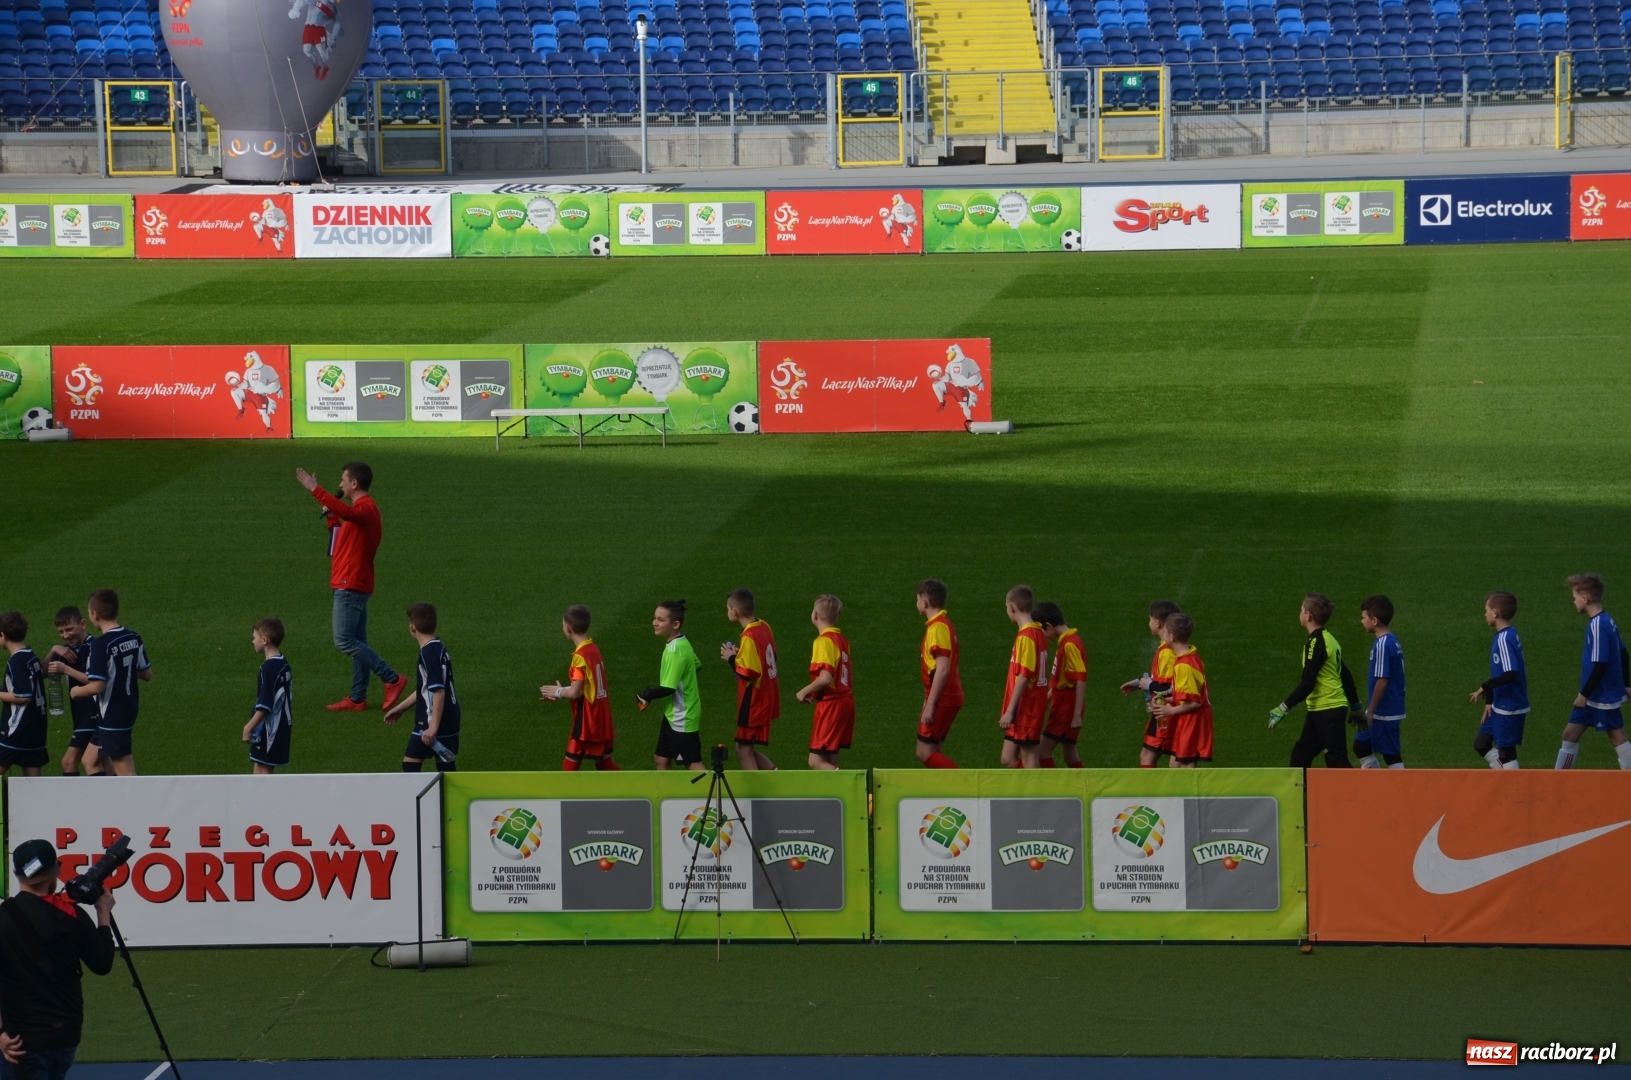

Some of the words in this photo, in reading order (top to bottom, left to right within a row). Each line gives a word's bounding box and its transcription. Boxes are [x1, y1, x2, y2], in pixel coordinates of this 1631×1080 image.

[171, 22, 191, 34] PZPN
[1126, 77, 1137, 86] 46
[866, 83, 877, 92] 45
[134, 91, 146, 100] 43
[406, 90, 417, 99] 44
[467, 208, 491, 216] TYMBARK
[969, 205, 994, 213] TYMBARK
[1032, 204, 1057, 212] TYMBARK
[1364, 208, 1389, 216] TYMBARK
[1457, 200, 1553, 217] Electrolux
[312, 206, 433, 226] DZIENNIK
[498, 209, 523, 218] TYMBARK
[560, 209, 586, 217] TYMBARK
[1113, 198, 1209, 233] Sport
[1291, 210, 1316, 218] TYMBARK
[20, 221, 46, 229] TYMBARK
[93, 221, 119, 229] TYMBARK
[657, 219, 681, 227] TYMBARK
[1582, 218, 1603, 226] PZPN
[313, 226, 433, 245] ZACHODNI
[548, 367, 582, 376] TYMBARK
[594, 368, 630, 378] TYMBARK
[647, 372, 668, 380] TYMBARK
[687, 367, 723, 377] TYMBARK
[363, 385, 399, 395] TYMBARK
[467, 384, 502, 394] TYMBARK
[775, 403, 803, 413] PZPN
[70, 410, 99, 420] PZPN
[123, 654, 134, 696] 7
[56, 824, 396, 849] PRZEGLĄD
[573, 844, 639, 862] TYMBARK
[764, 844, 830, 861] TYMBARK
[1003, 844, 1069, 861] TYMBARK
[1197, 843, 1264, 861] TYMBARK
[499, 865, 541, 874] PODWÓRKA
[929, 864, 971, 873] PODWÓRKA
[1122, 863, 1164, 872] PODWÓRKA
[516, 883, 556, 891] TYMBARKU
[669, 882, 674, 890] O
[907, 882, 912, 890] O
[914, 882, 944, 890] PUCHAR
[945, 882, 986, 890] TYMBARKU
[1100, 882, 1105, 890] O
[1107, 882, 1137, 890] PUCHAR
[1139, 882, 1180, 890] TYMBARKU
[938, 896, 958, 904] PZPN
